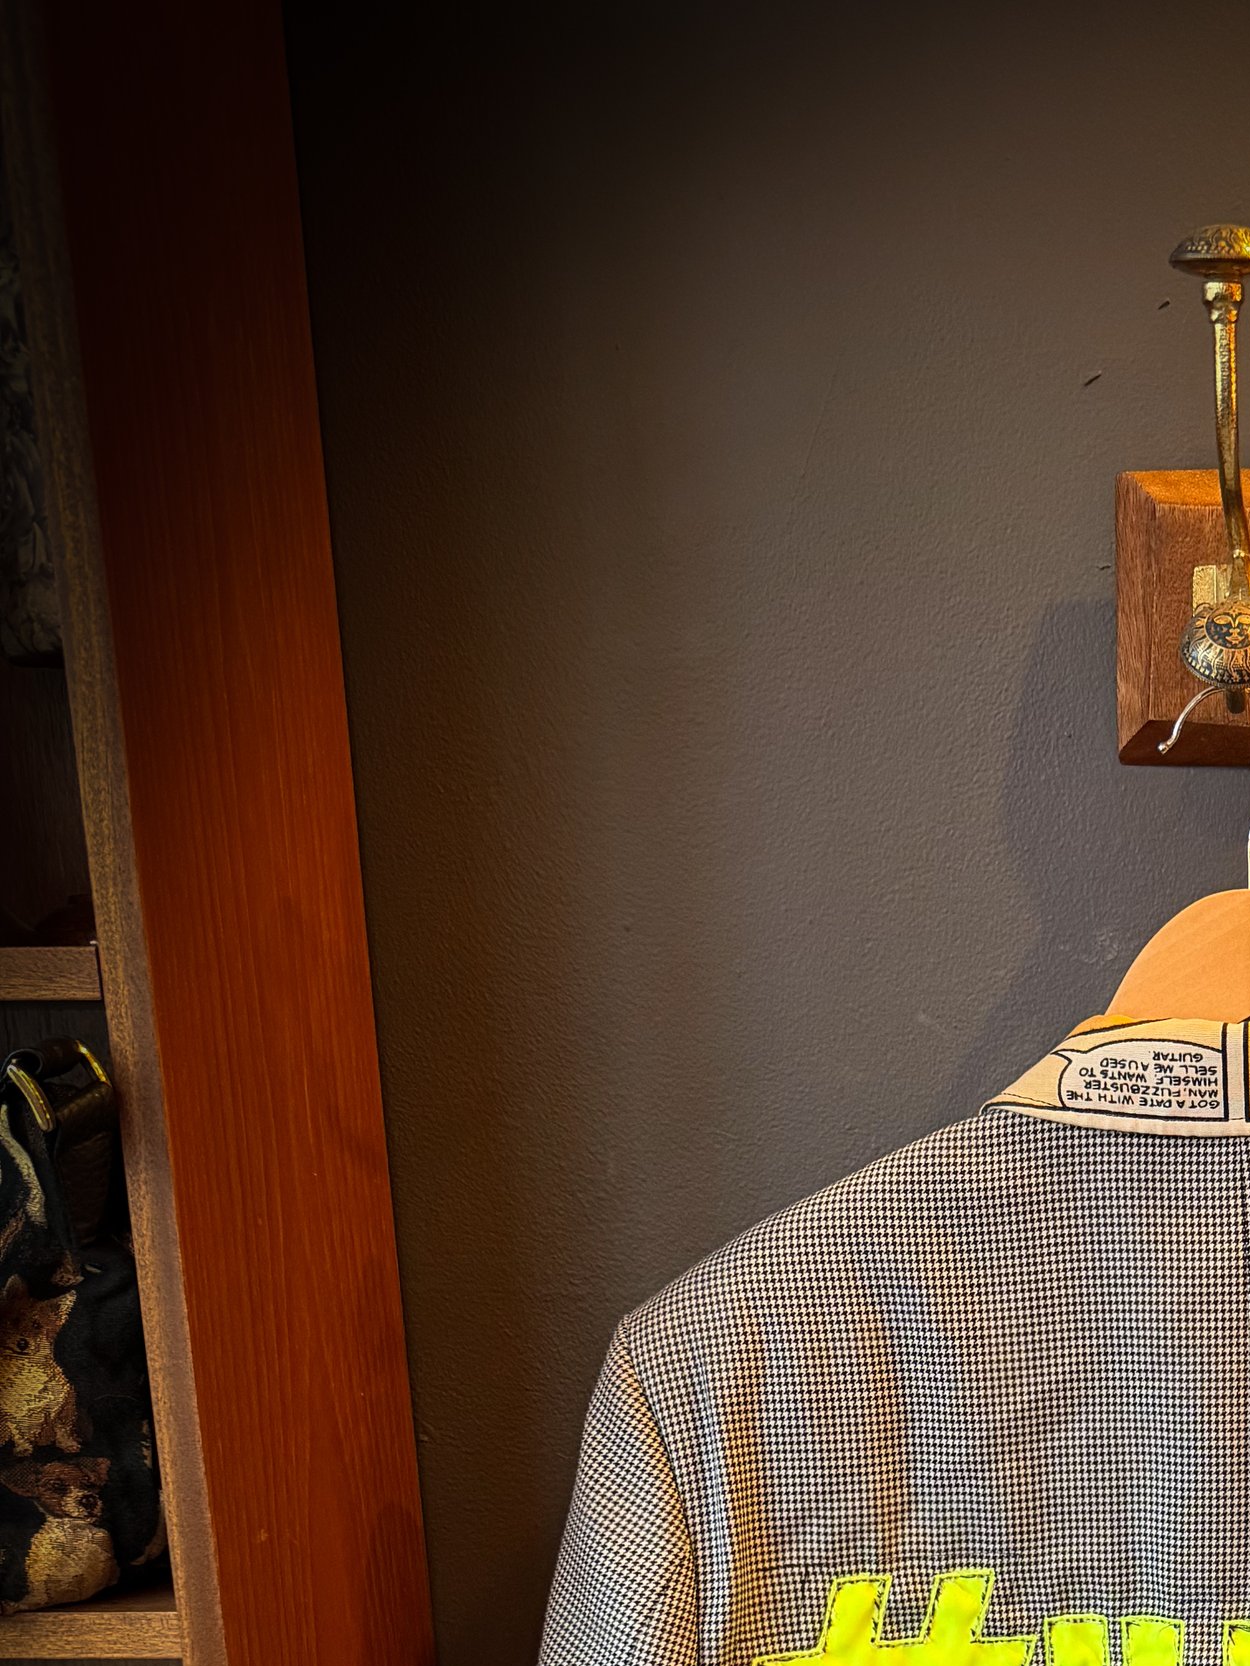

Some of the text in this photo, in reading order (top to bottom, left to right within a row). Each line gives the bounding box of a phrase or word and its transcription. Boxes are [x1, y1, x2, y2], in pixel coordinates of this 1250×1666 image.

[1079, 1067, 1096, 1078] TO
[1153, 1064, 1174, 1074] ME
[1179, 1065, 1217, 1075] SELL
[1100, 1069, 1147, 1083] WANTS
[1083, 1080, 1181, 1098] FUZZBUSTER
[1066, 1090, 1220, 1109] GOT A DATE WITH THE
